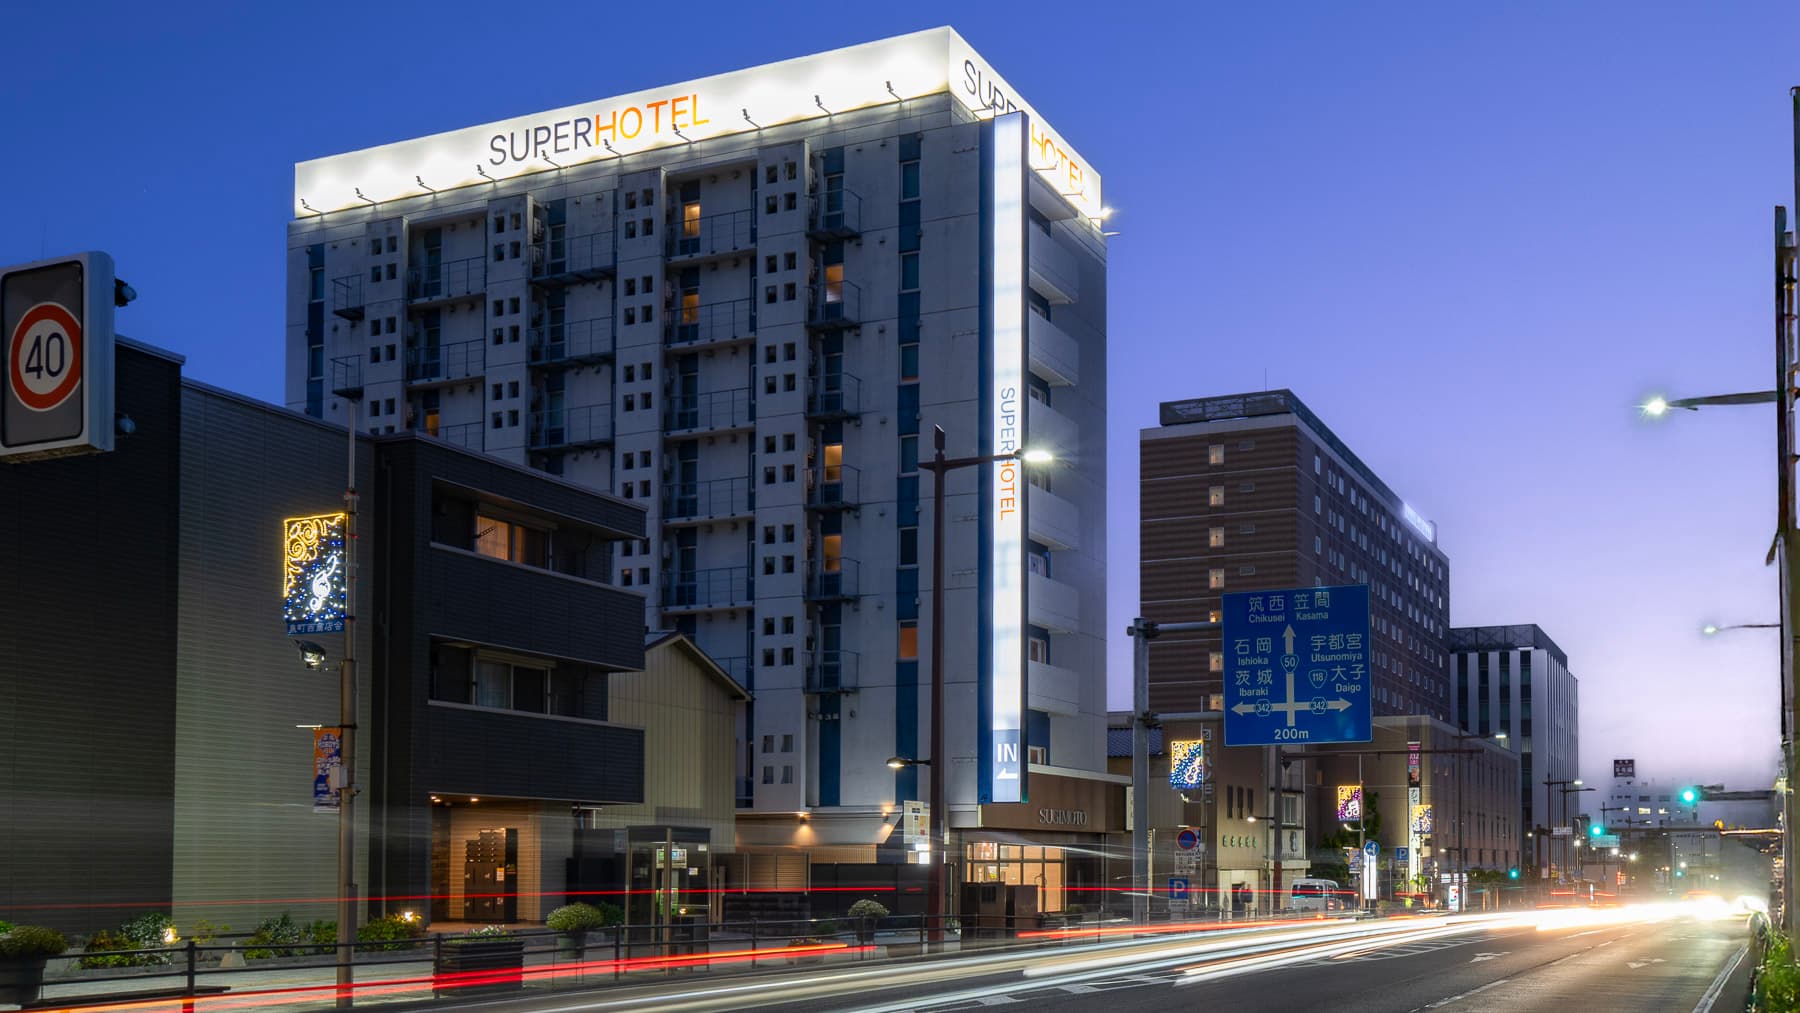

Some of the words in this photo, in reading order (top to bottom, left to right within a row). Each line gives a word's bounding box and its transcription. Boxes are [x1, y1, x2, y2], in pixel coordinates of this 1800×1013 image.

[25, 332, 65, 380] 40
[1249, 595, 1285, 613] 筑西
[1294, 591, 1330, 610] 笠間
[1248, 613, 1285, 624] Chikusei
[1296, 611, 1329, 621] Kasama
[1234, 637, 1272, 655] 石岡
[1311, 633, 1362, 652] 宇都宮
[1238, 656, 1269, 666] Ishioka
[1284, 657, 1296, 667] 50
[1311, 652, 1363, 664] Utsunomiya
[1235, 669, 1273, 686] 茨城
[1312, 673, 1324, 682] 118
[1330, 664, 1366, 682] 大子
[1239, 686, 1269, 697] Ibaraki
[1335, 683, 1361, 694] Daigo
[1257, 703, 1270, 712] 342
[1312, 701, 1326, 710] 342
[1274, 728, 1309, 740] 200m
[997, 743, 1018, 762] IN
[1039, 807, 1089, 826] SUGIMOTO
[1173, 880, 1186, 898] P
